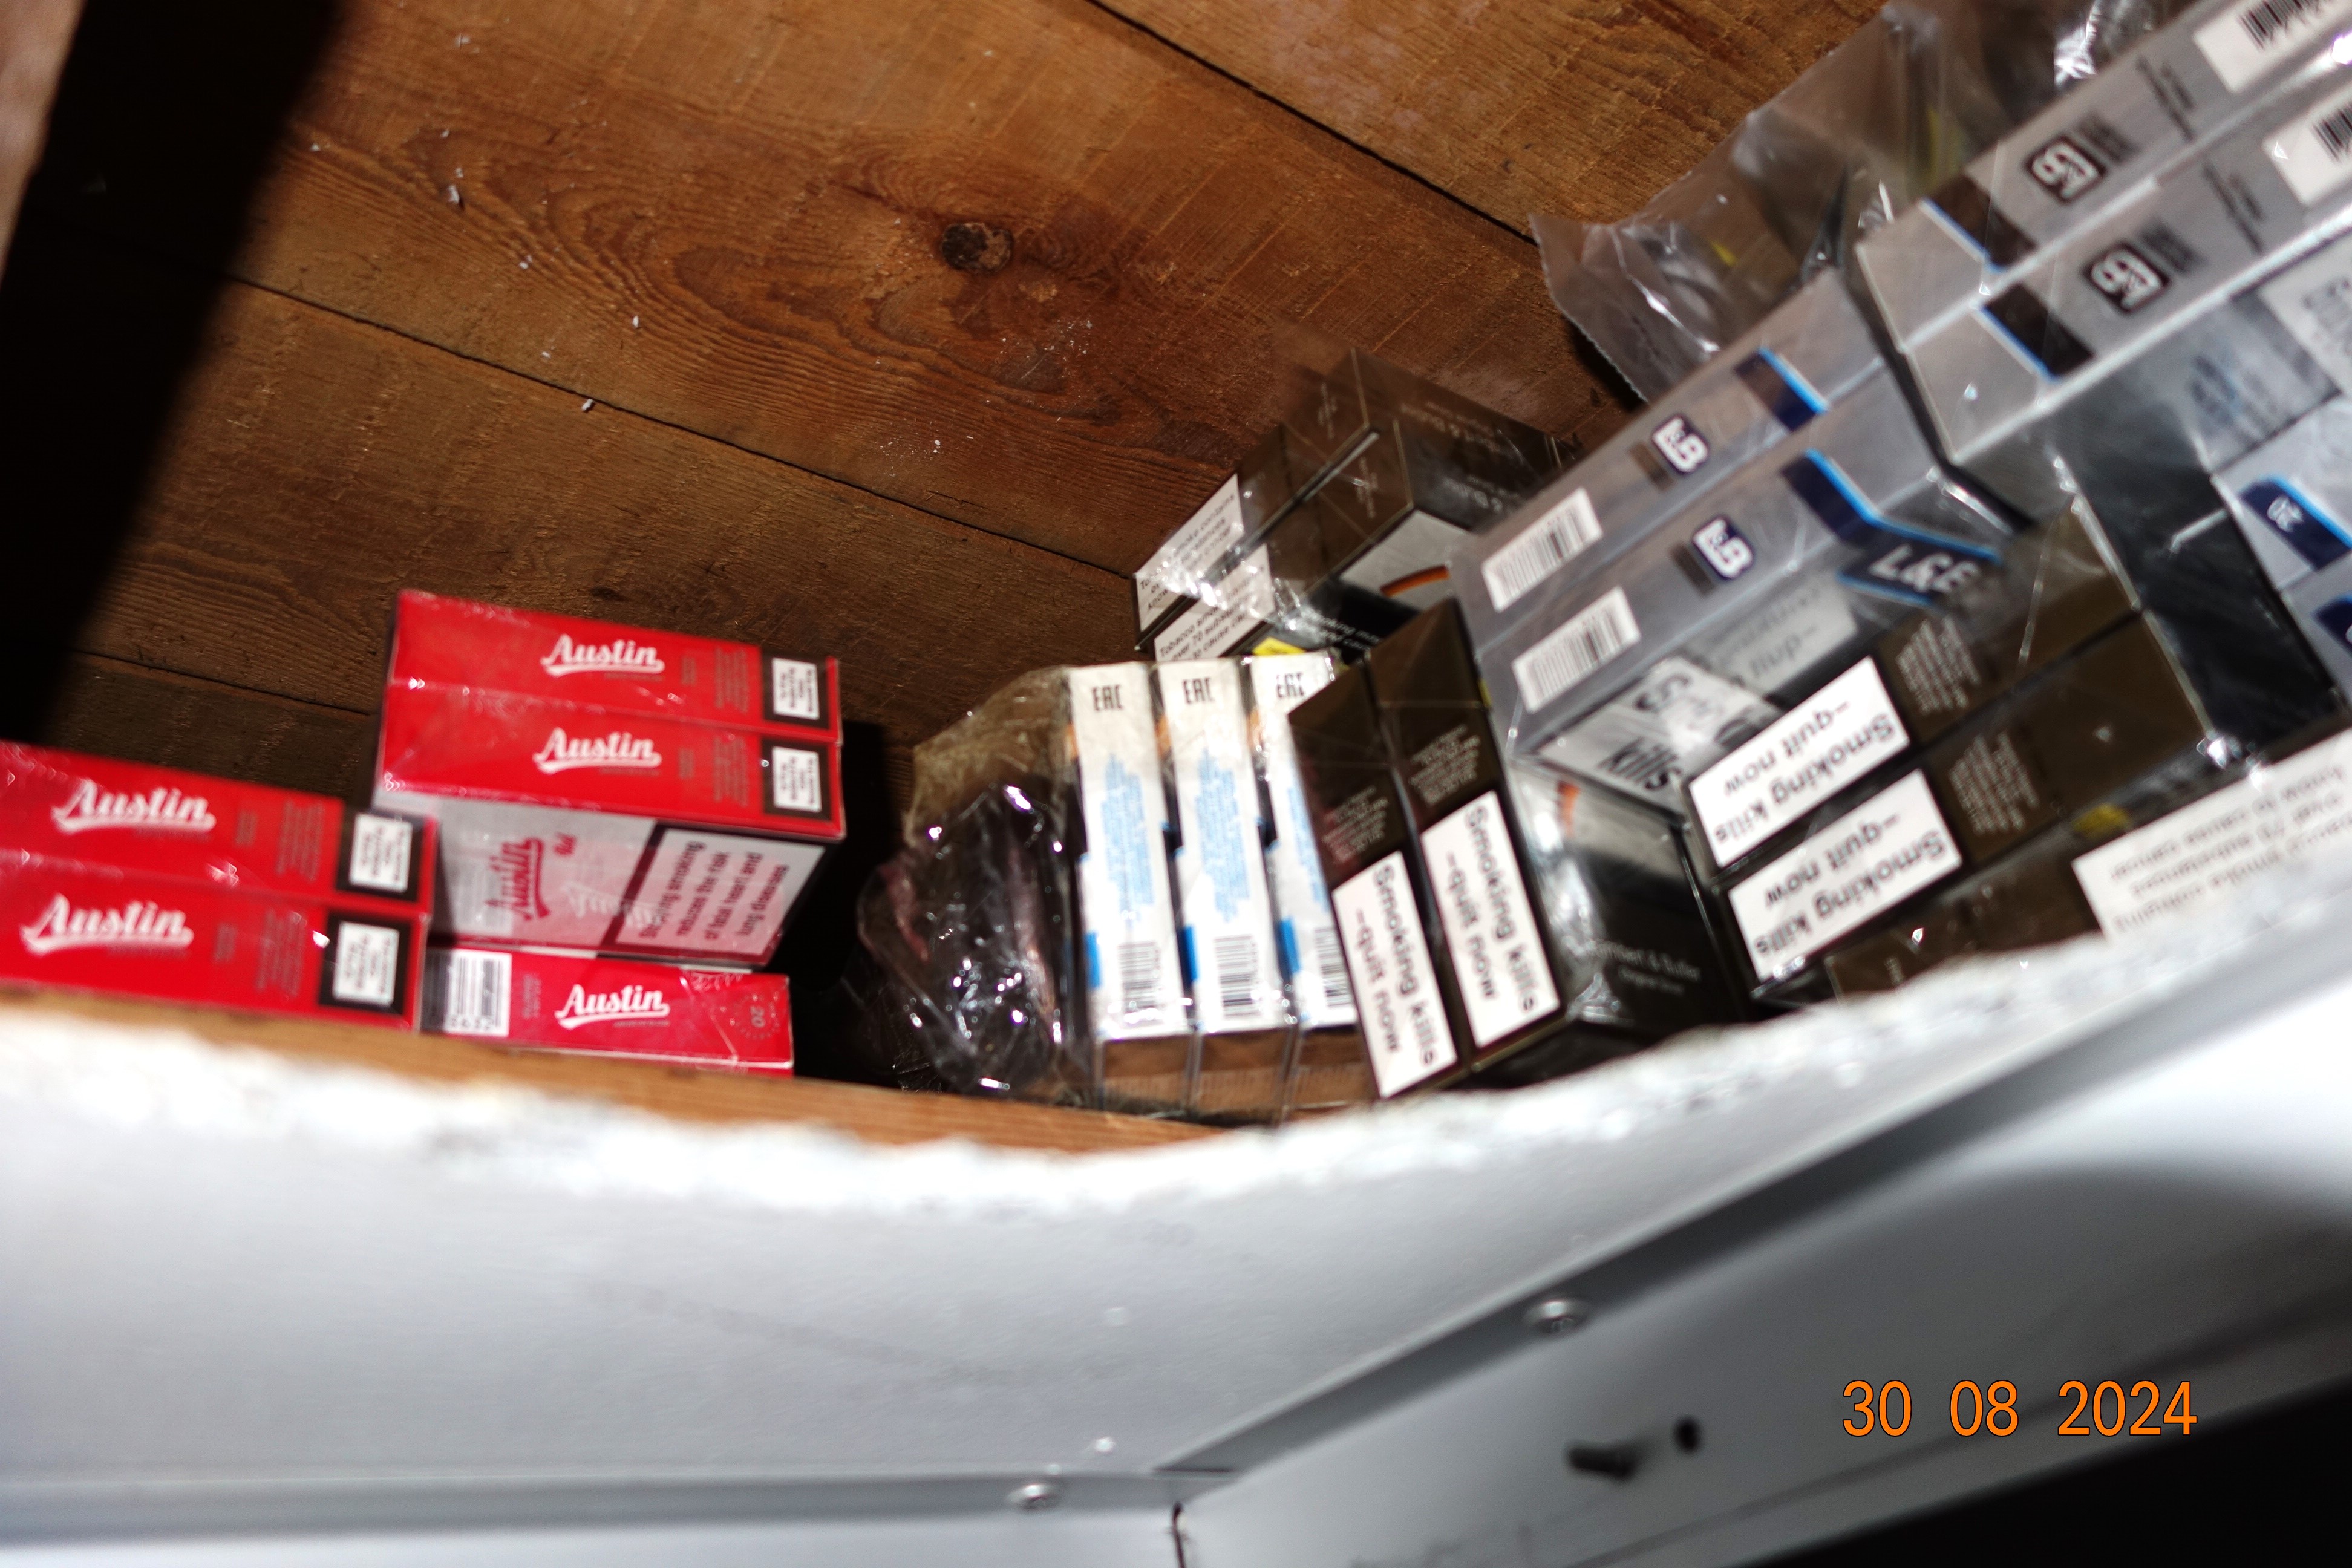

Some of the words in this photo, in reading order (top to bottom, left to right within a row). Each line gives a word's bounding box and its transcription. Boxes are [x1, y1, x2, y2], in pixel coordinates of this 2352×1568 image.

[540, 633, 665, 676] Austin
[532, 727, 662, 775] Austin
[1727, 749, 1779, 798] now
[1770, 714, 1895, 803] Smoking
[51, 779, 217, 835] Austin
[1714, 800, 1769, 844] kills
[1766, 860, 1822, 909] now
[1814, 831, 1946, 920] Smoking
[20, 894, 194, 954] Austin
[1465, 806, 1517, 939] Smoking
[1508, 946, 1537, 1010] kills
[1756, 912, 1812, 954] kills
[1373, 866, 1418, 996] Smoking
[1411, 1001, 1439, 1063] kills
[1466, 935, 1498, 998] now
[555, 984, 670, 1030] Austin
[1373, 989, 1402, 1051] now
